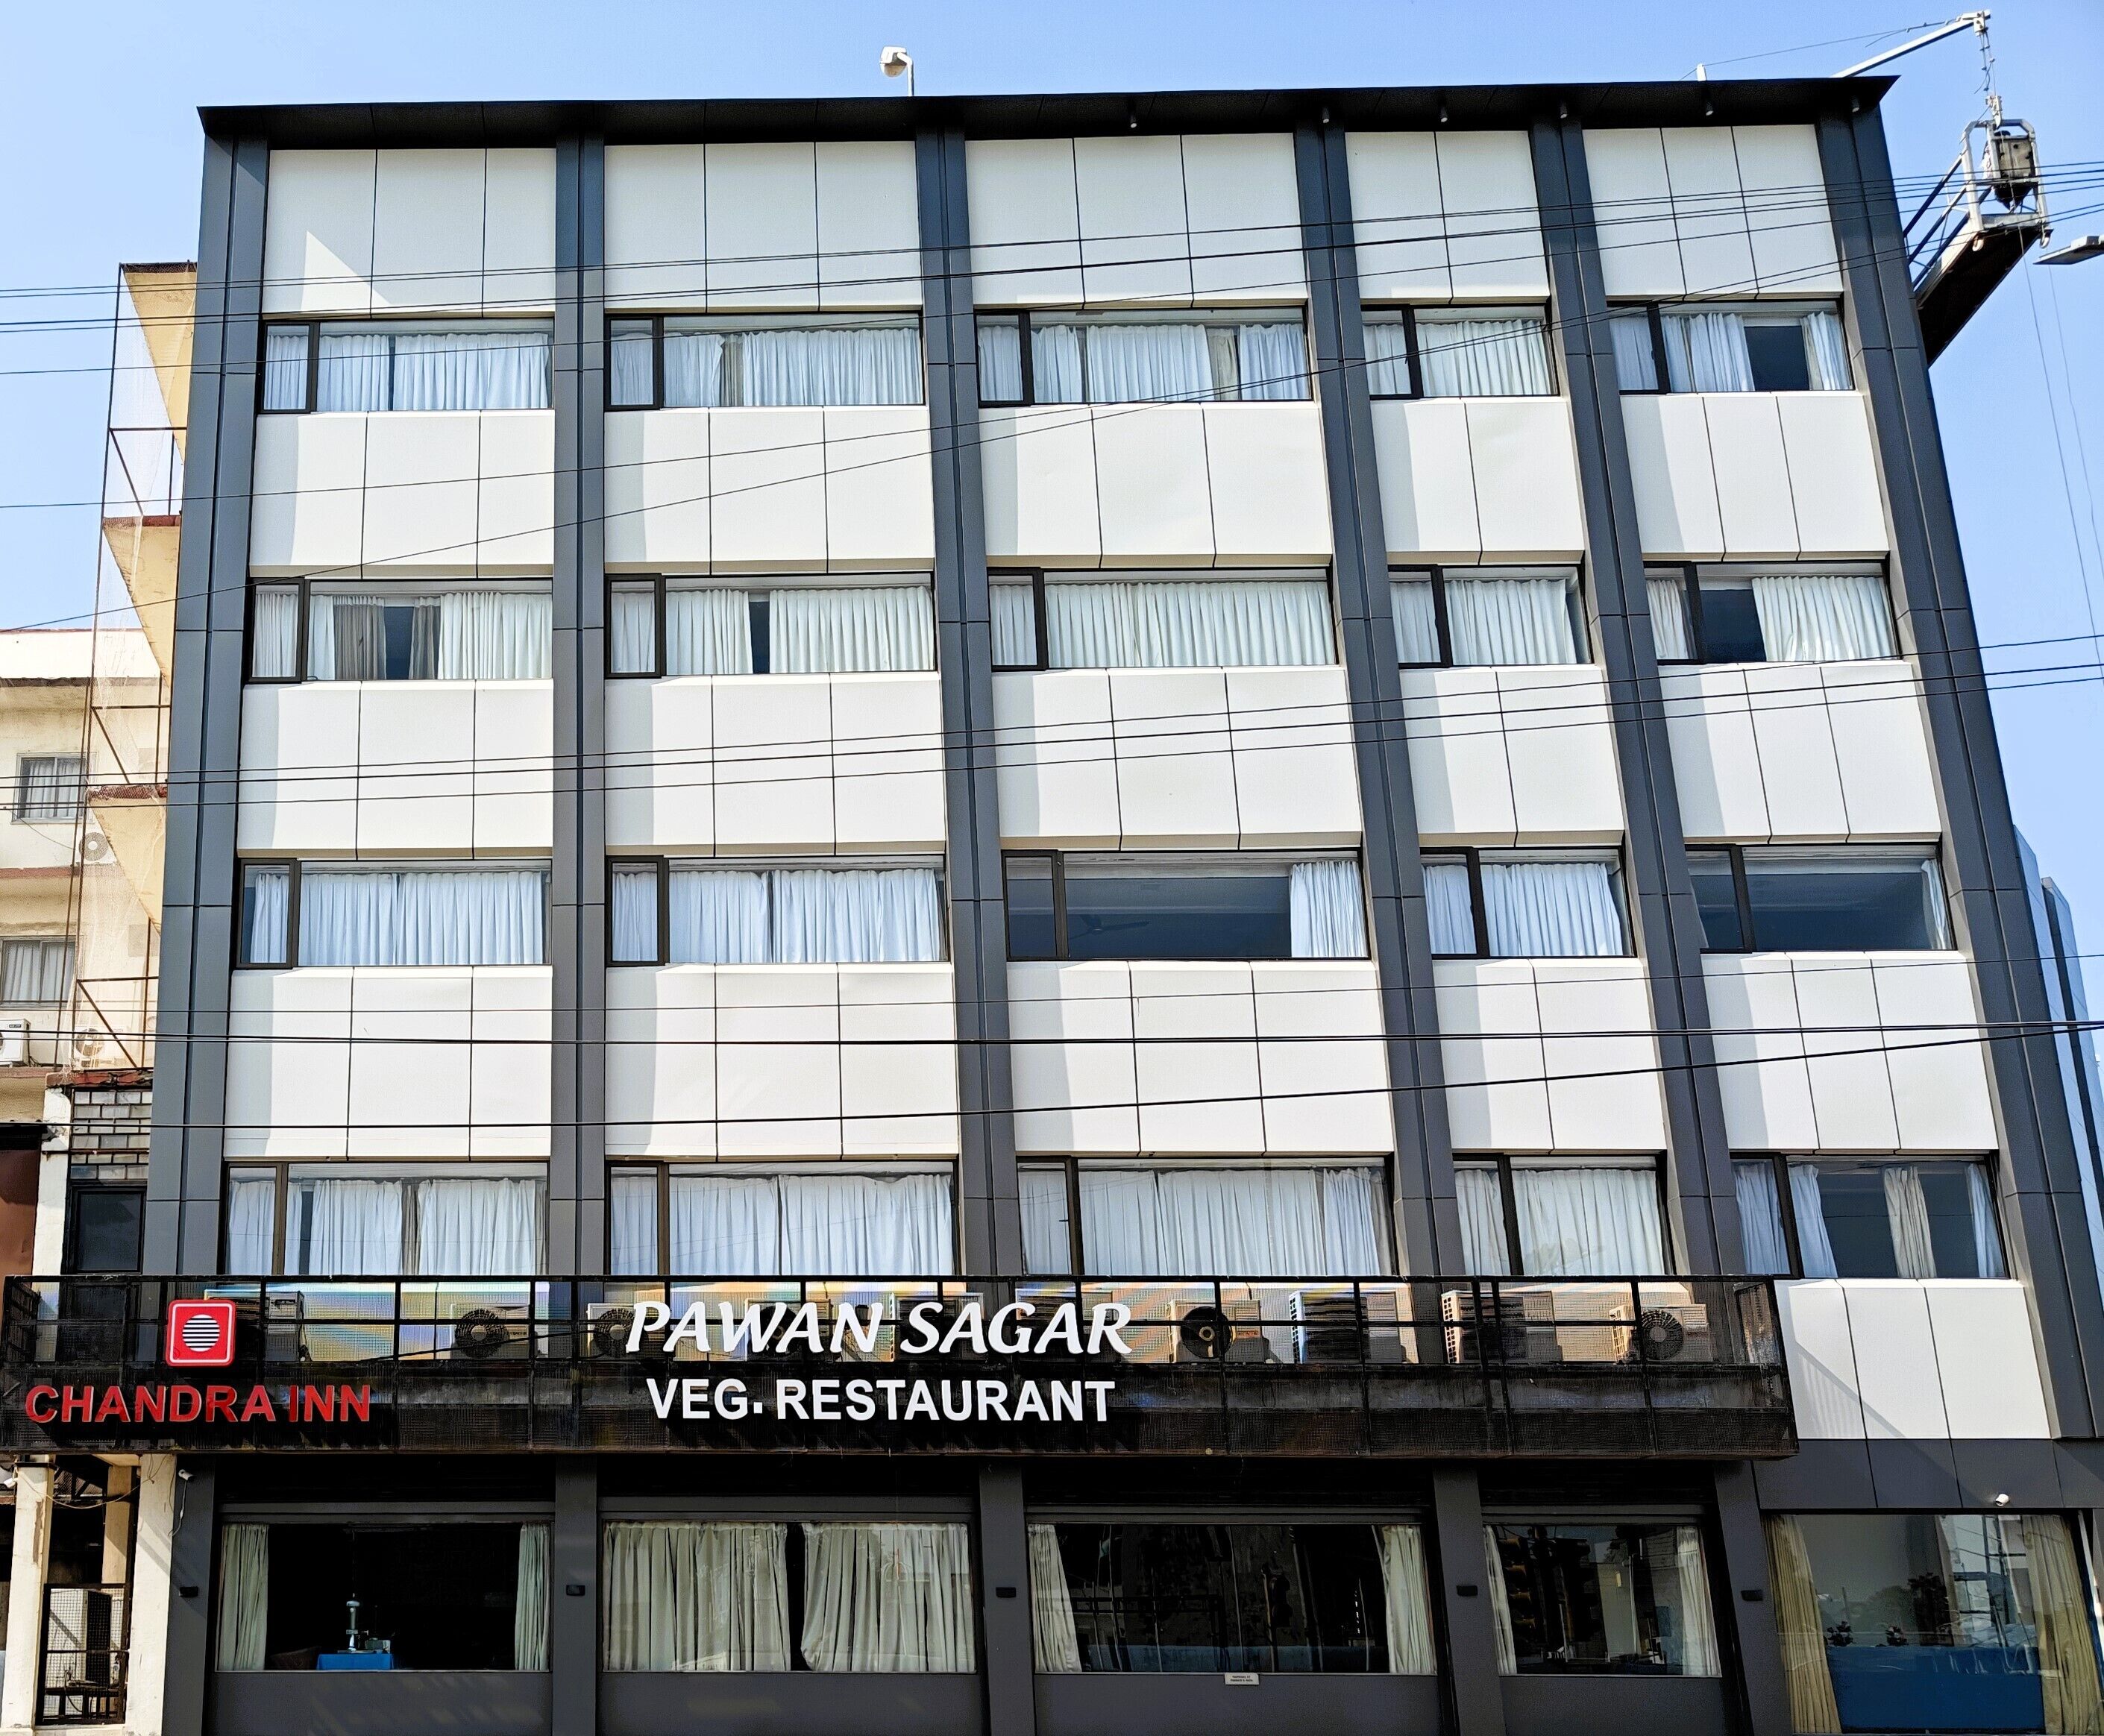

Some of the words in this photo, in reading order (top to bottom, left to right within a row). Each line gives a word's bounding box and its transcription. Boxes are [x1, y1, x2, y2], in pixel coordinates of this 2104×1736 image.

[624, 1301, 885, 1354] PAWAN
[899, 1301, 1134, 1355] SAGAR
[25, 1384, 276, 1424] CHANDRA
[289, 1383, 371, 1422] INN
[646, 1377, 764, 1420] VEG.
[776, 1378, 1117, 1422] RESTAURANT
